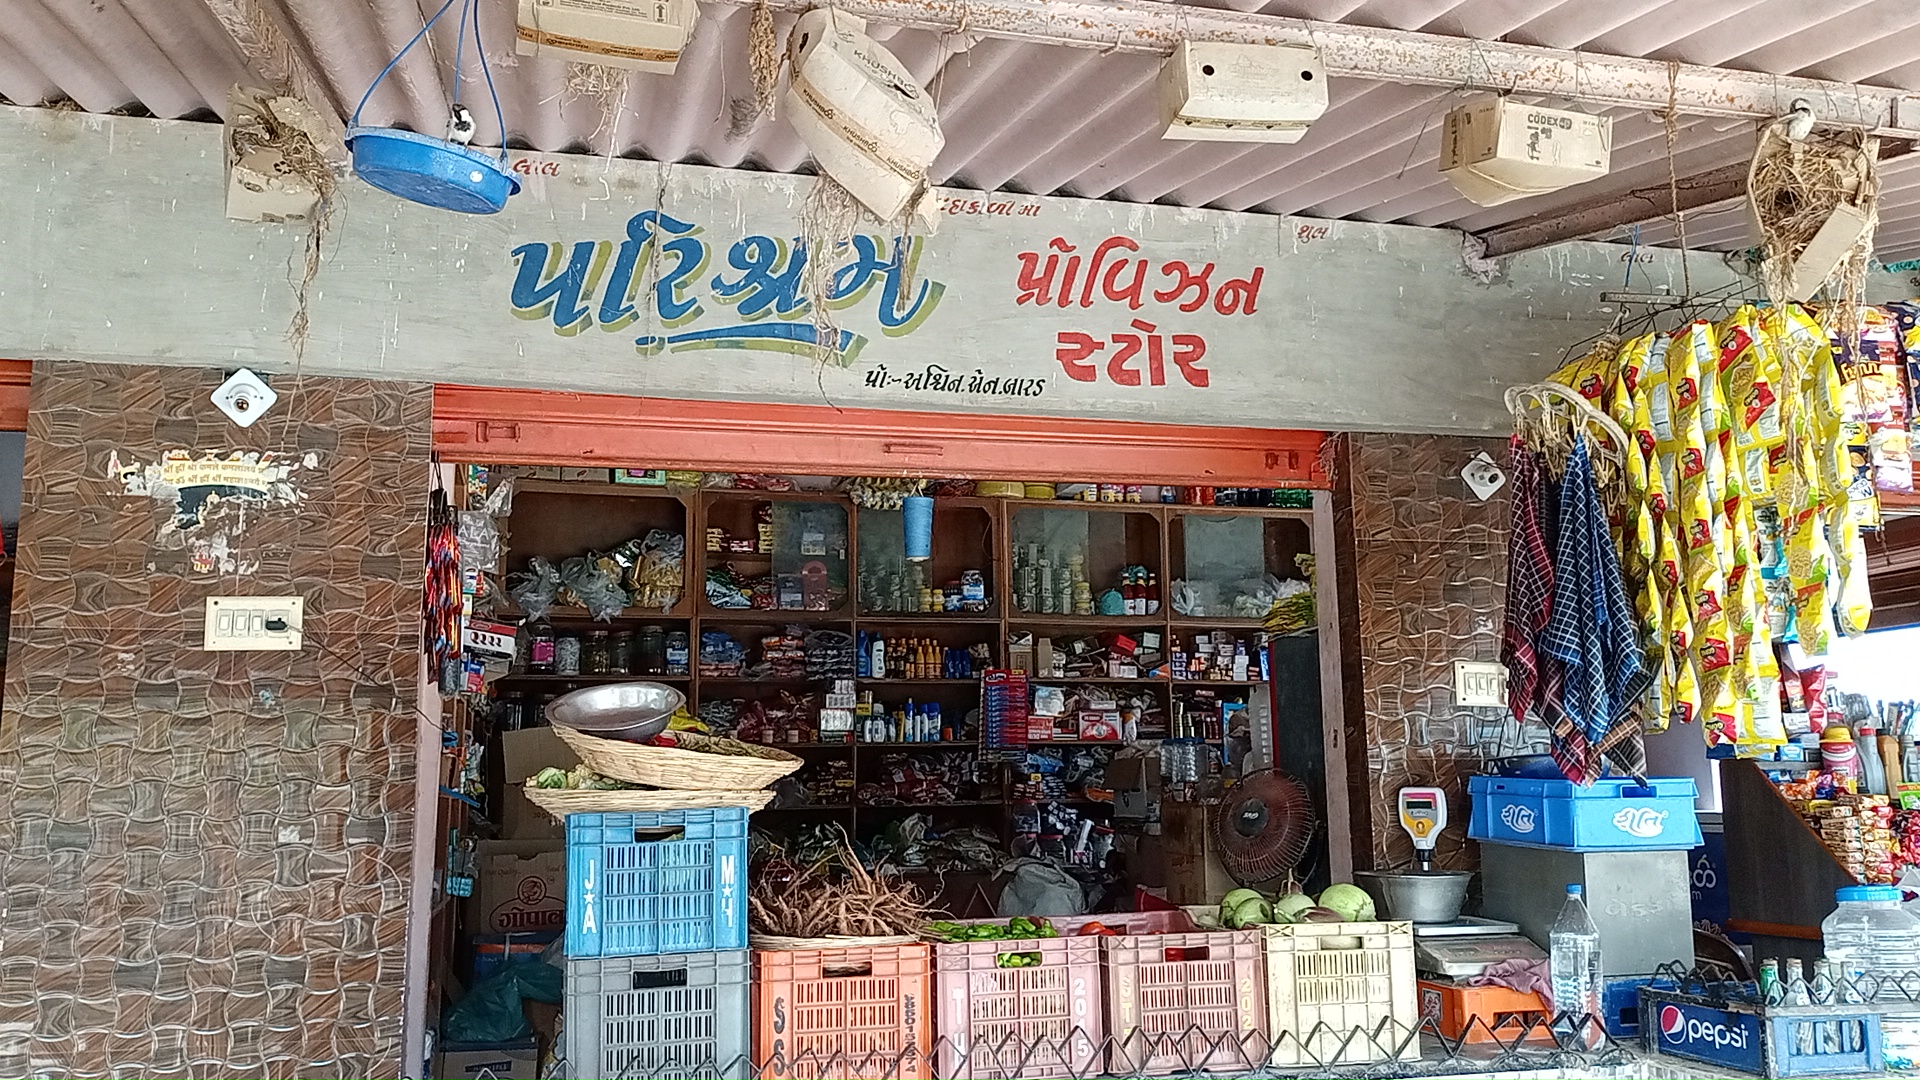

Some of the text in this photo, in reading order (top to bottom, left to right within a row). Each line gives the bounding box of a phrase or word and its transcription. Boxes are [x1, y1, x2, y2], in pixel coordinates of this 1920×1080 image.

[1527, 113, 1558, 126] CODEX
[509, 209, 946, 337] પરિશ્રમ
[1055, 318, 1210, 388] સ્ટોર
[1688, 1016, 1748, 1050] pepsi
